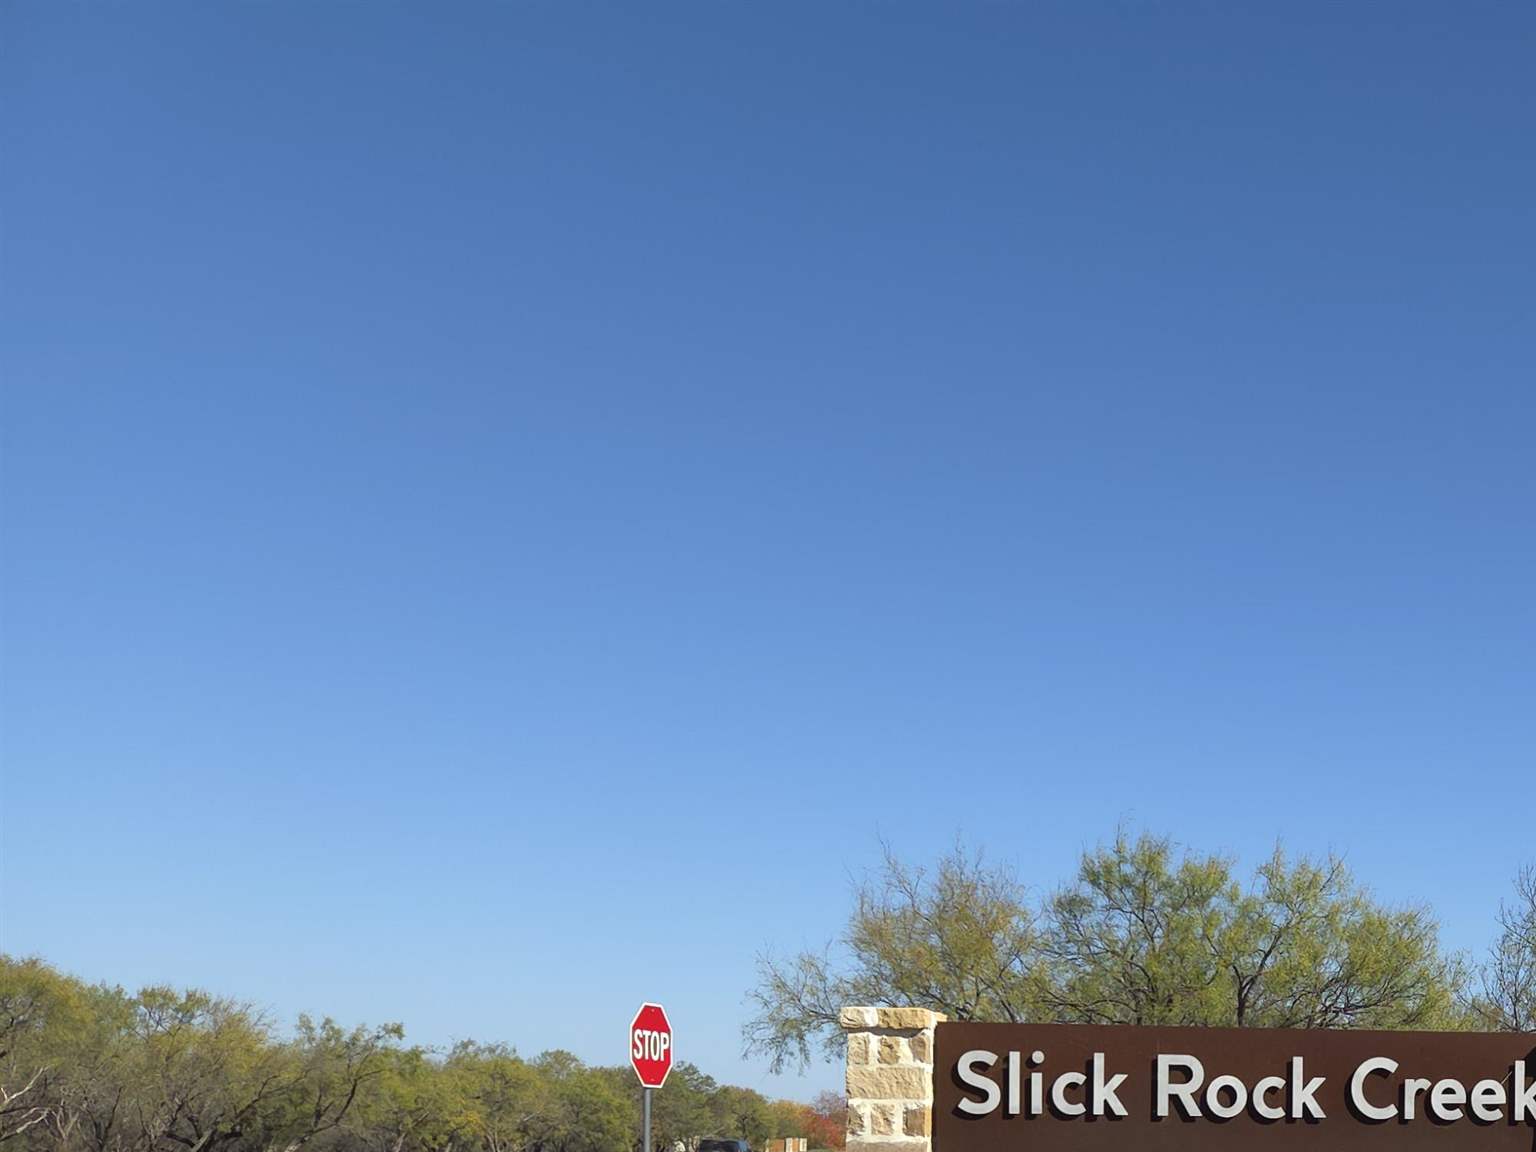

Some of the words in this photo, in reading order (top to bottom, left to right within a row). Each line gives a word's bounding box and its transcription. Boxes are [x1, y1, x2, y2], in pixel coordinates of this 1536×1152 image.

[633, 1029, 669, 1061] STOP
[956, 1050, 1129, 1117] Slick
[1156, 1053, 1327, 1119] Rock
